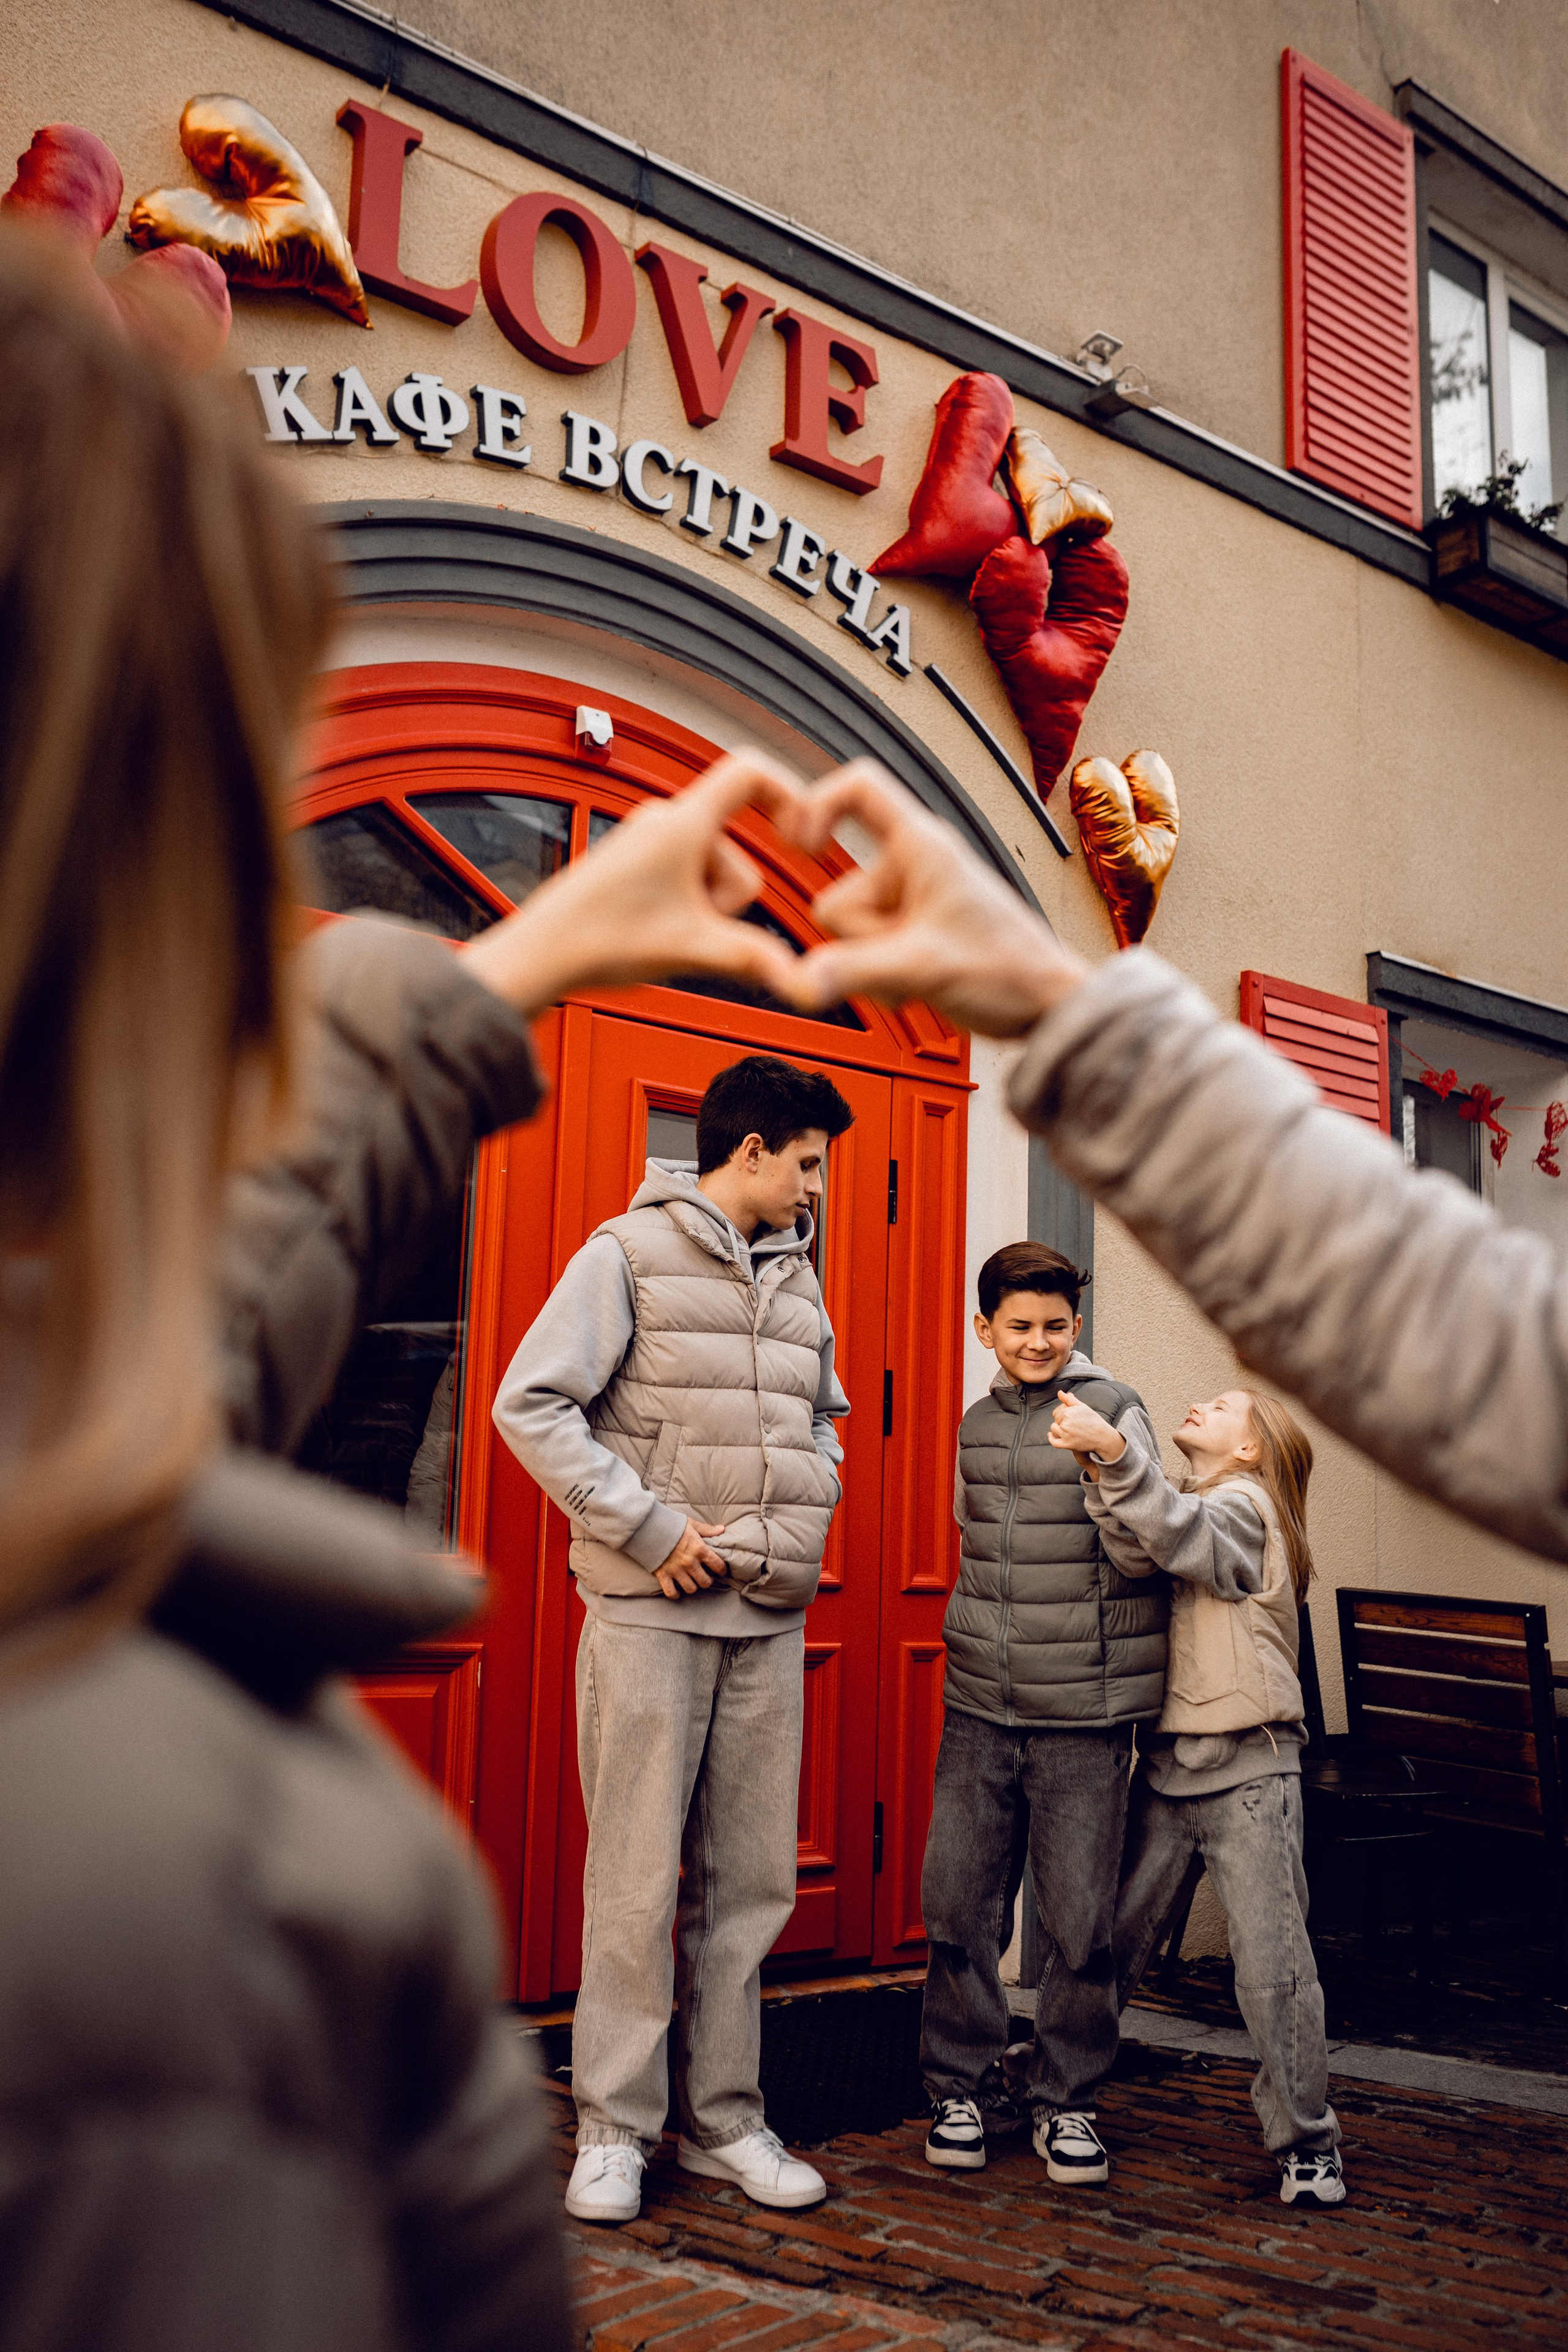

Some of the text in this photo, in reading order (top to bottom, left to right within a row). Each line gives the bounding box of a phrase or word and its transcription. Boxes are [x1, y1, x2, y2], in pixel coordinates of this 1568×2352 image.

[336, 99, 884, 496] LOVE
[247, 366, 913, 678] КАФЕ ВСТРЕЧА
